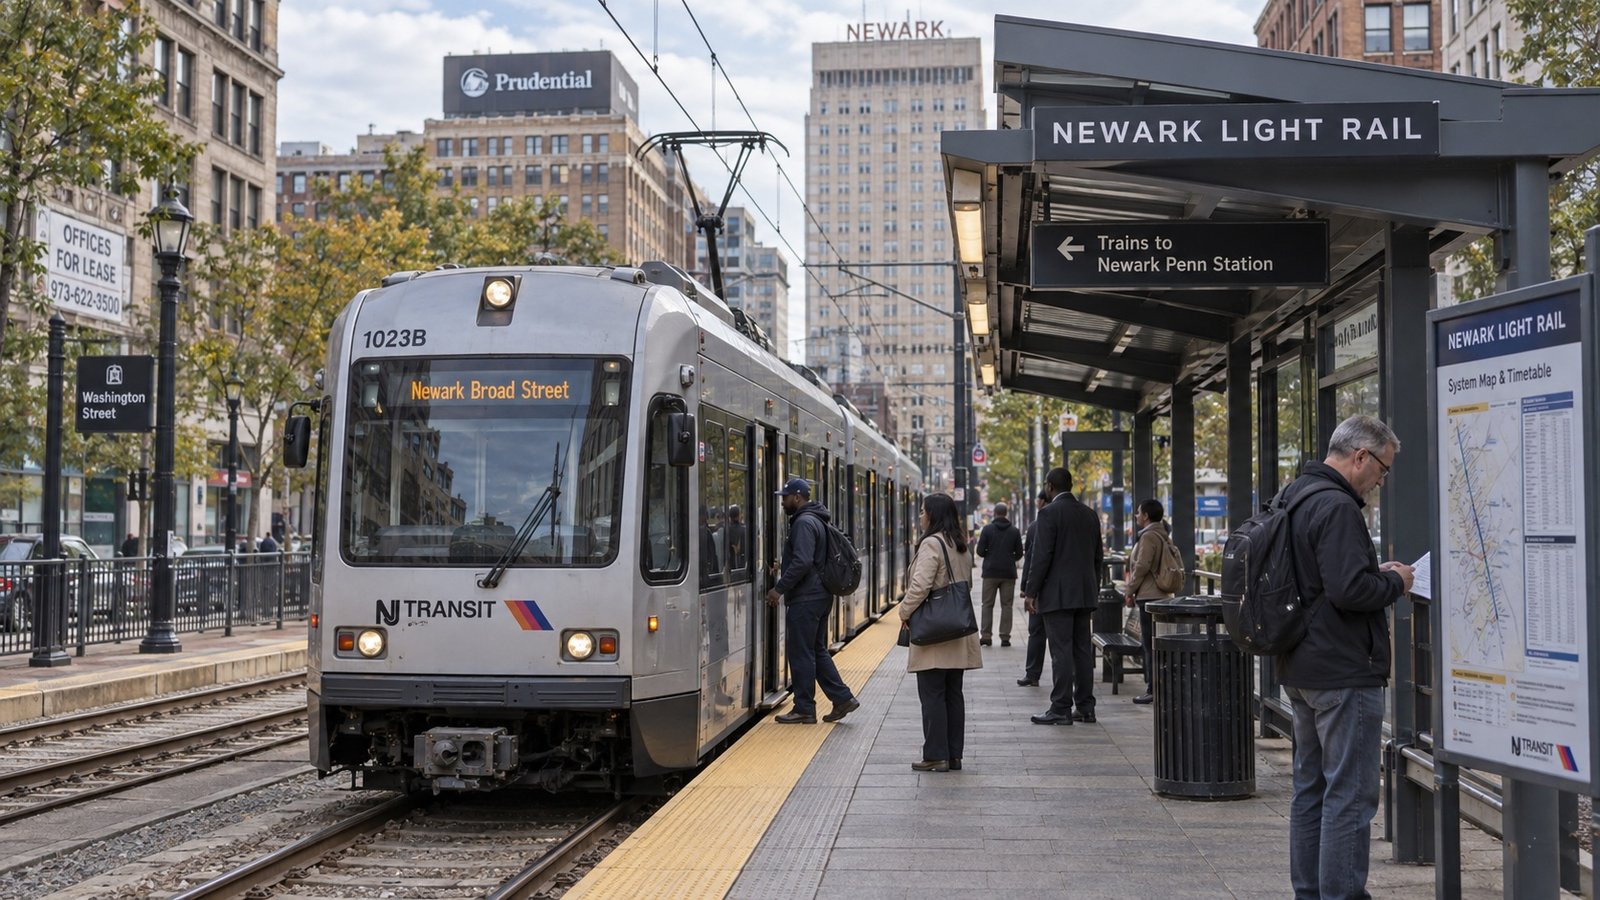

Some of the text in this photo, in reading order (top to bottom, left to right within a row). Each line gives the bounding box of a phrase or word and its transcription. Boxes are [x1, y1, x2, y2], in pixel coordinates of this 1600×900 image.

[847, 20, 945, 41] NEWARK
[495, 69, 593, 92] Prudential
[1052, 117, 1422, 144] NEWARK LIGHT RAIL
[63, 225, 111, 256] OFFICES
[1097, 235, 1173, 251] Trains to
[56, 248, 116, 284] FOR LEASE
[1097, 255, 1273, 272] Newark Penn Station
[51, 280, 119, 314] 973-622-3500
[363, 329, 426, 348] 1023B
[1448, 310, 1566, 350] NEWARK LIGHT RAIL
[1448, 363, 1552, 395] System Map & Timetable
[82, 391, 146, 406] Washington
[411, 380, 570, 400] Newark Broad Street
[82, 407, 117, 420] Street
[404, 601, 496, 616] TRANSIT
[1522, 738, 1554, 756] TRANSIT
